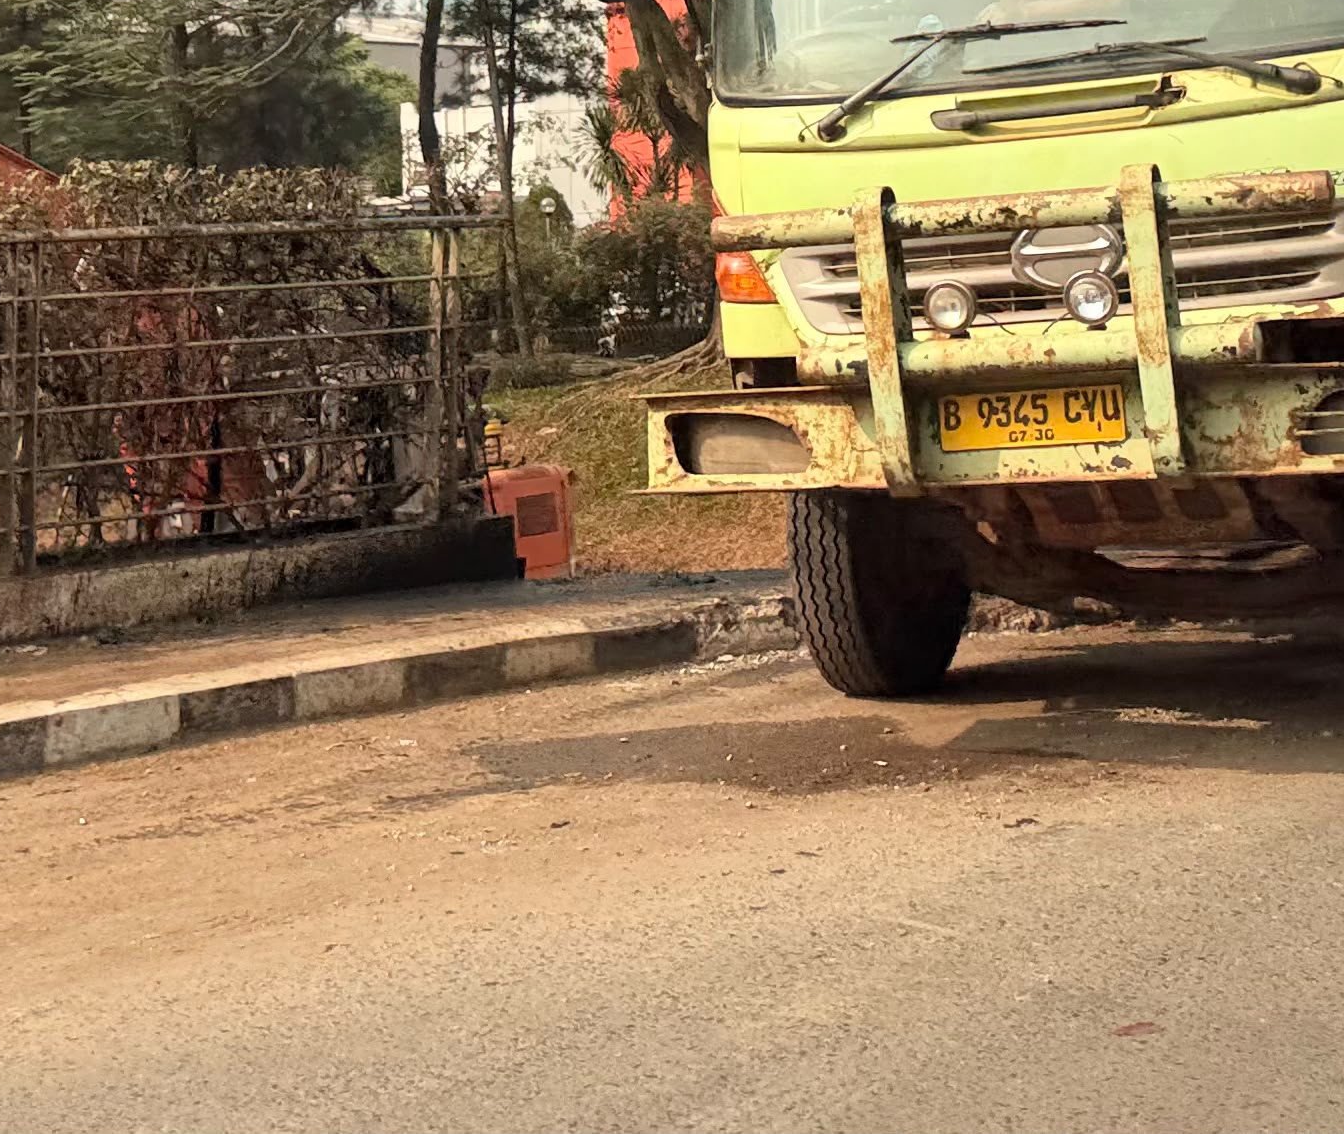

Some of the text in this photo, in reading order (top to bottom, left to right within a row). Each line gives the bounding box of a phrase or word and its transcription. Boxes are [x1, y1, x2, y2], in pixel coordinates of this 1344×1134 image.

[943, 389, 1122, 432] B 9345 CYU
